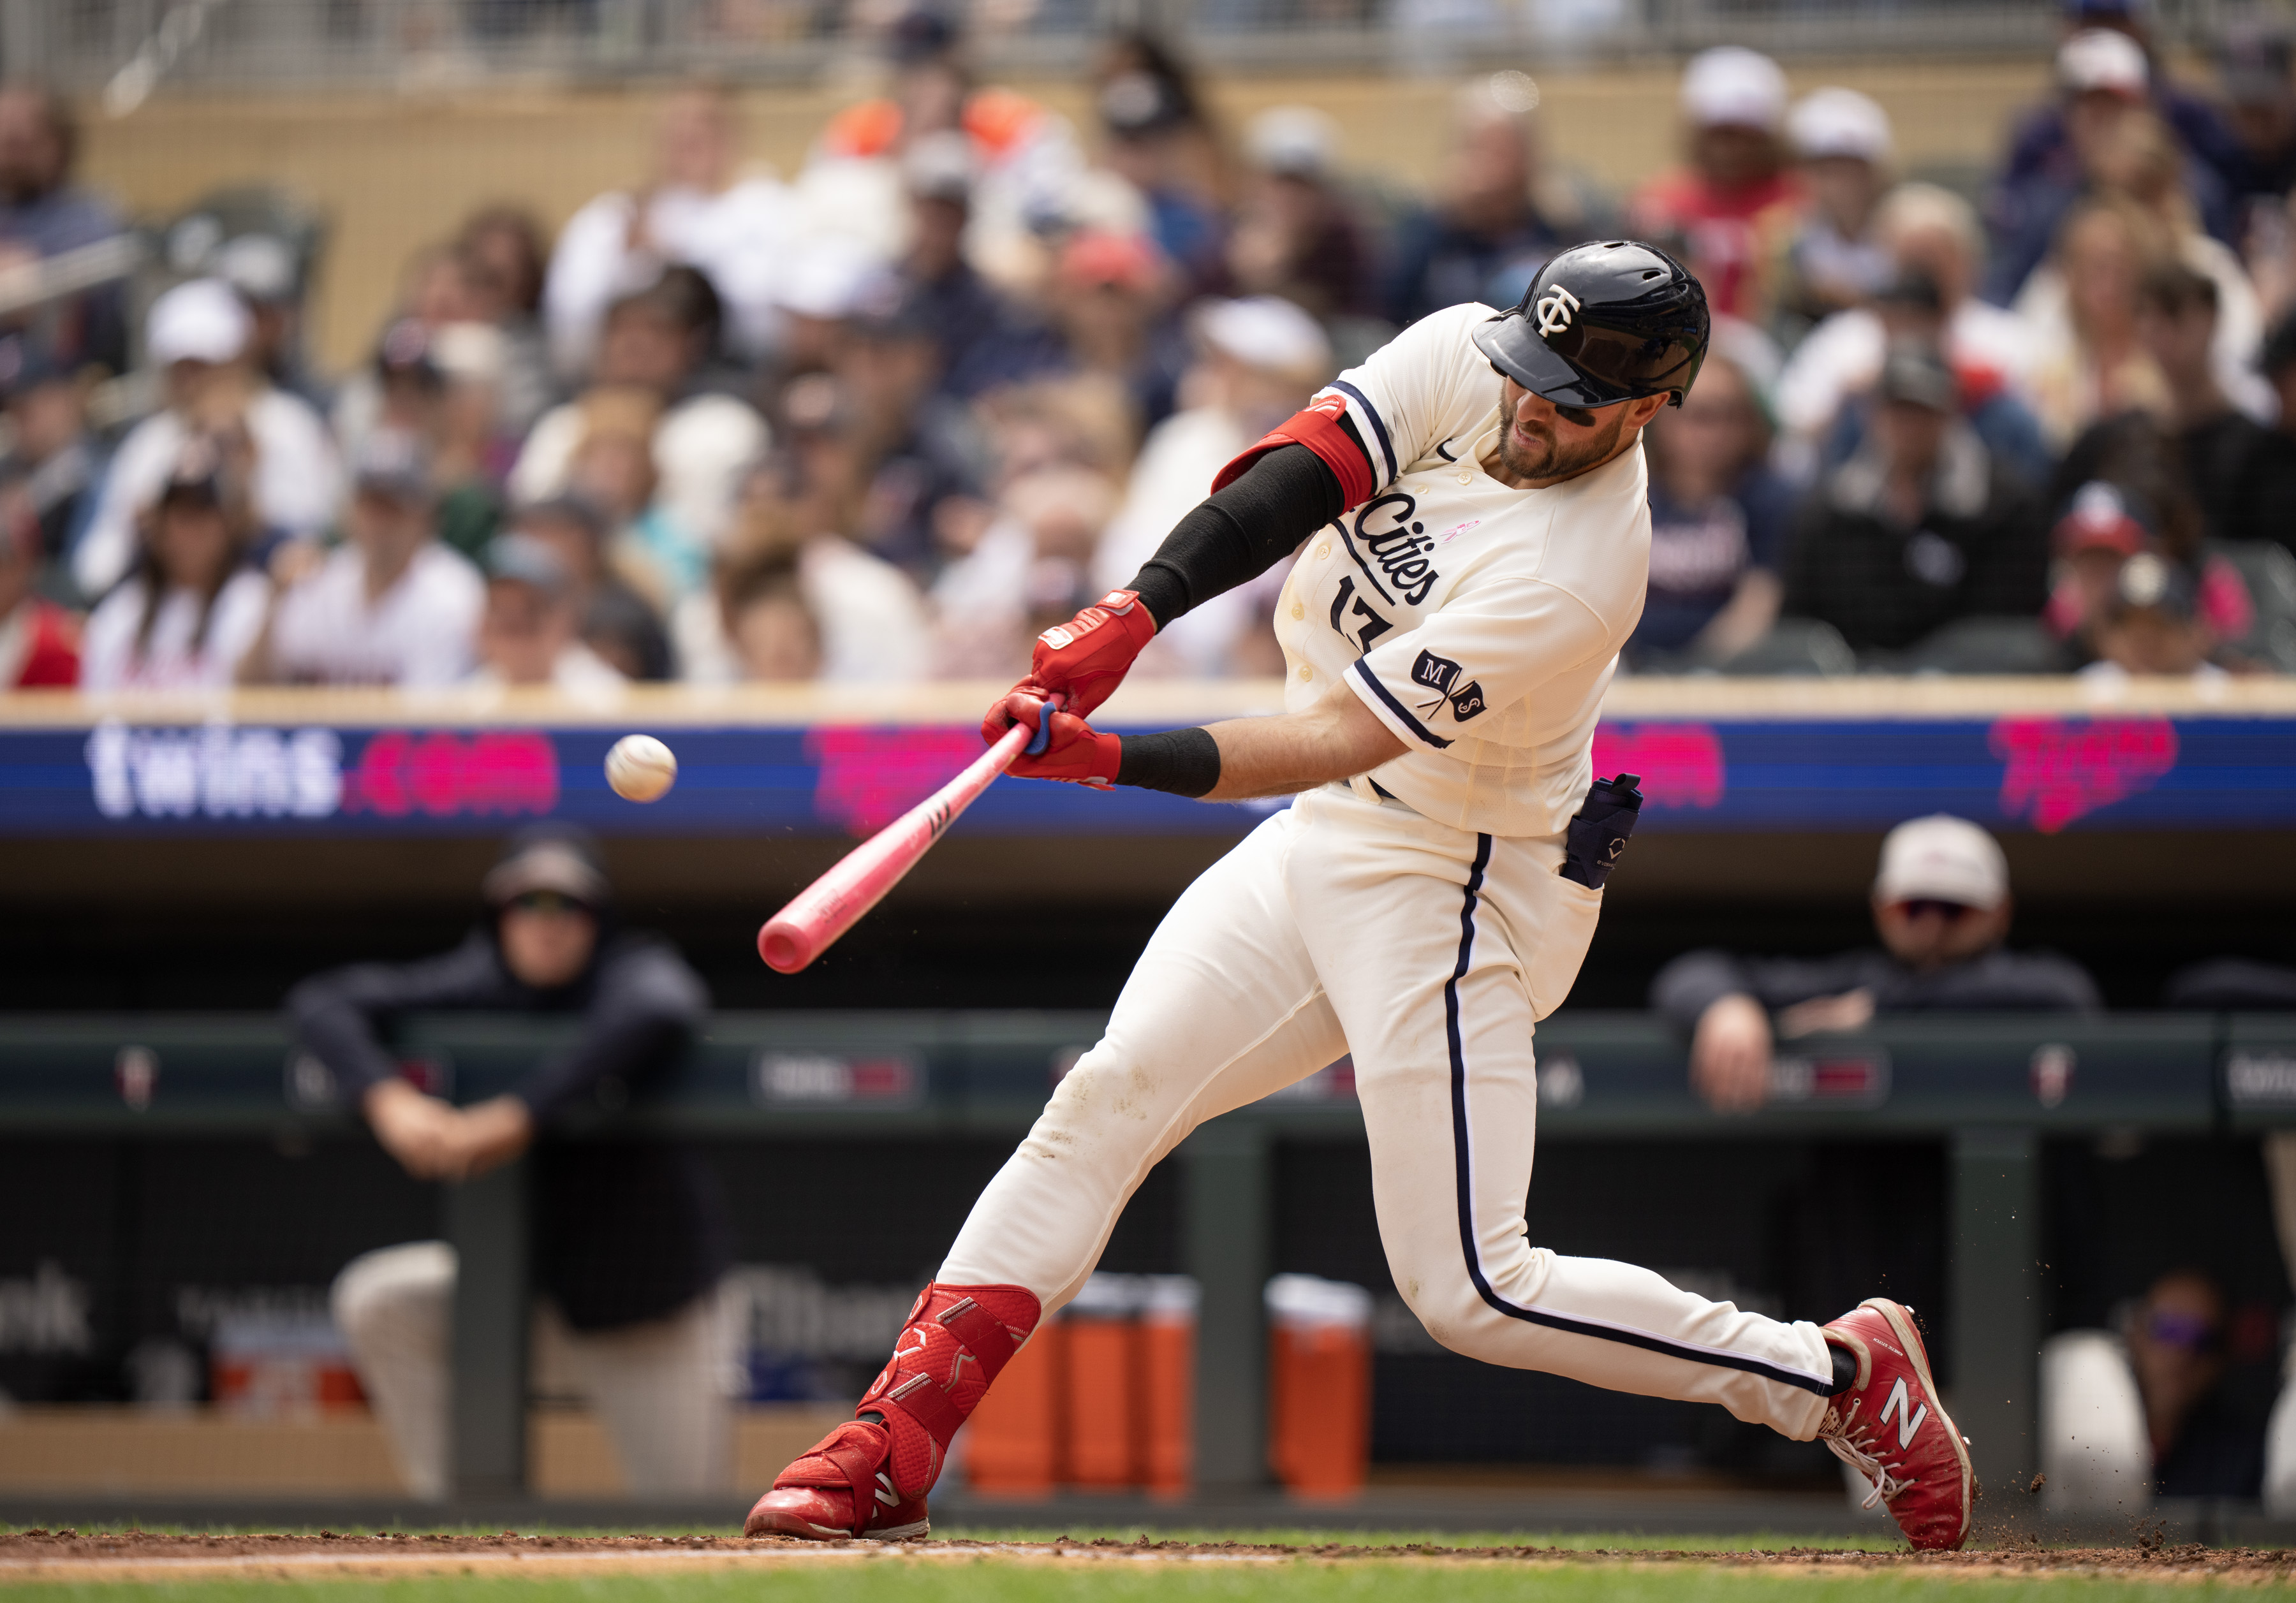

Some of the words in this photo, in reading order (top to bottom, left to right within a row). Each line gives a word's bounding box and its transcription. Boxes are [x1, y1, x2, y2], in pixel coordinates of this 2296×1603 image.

[1355, 493, 1439, 606] Cities
[1420, 658, 1447, 685] M
[1873, 1337, 1888, 1348] STITCH
[1887, 1345, 1904, 1357] KINETIC
[1878, 1374, 1929, 1453] N
